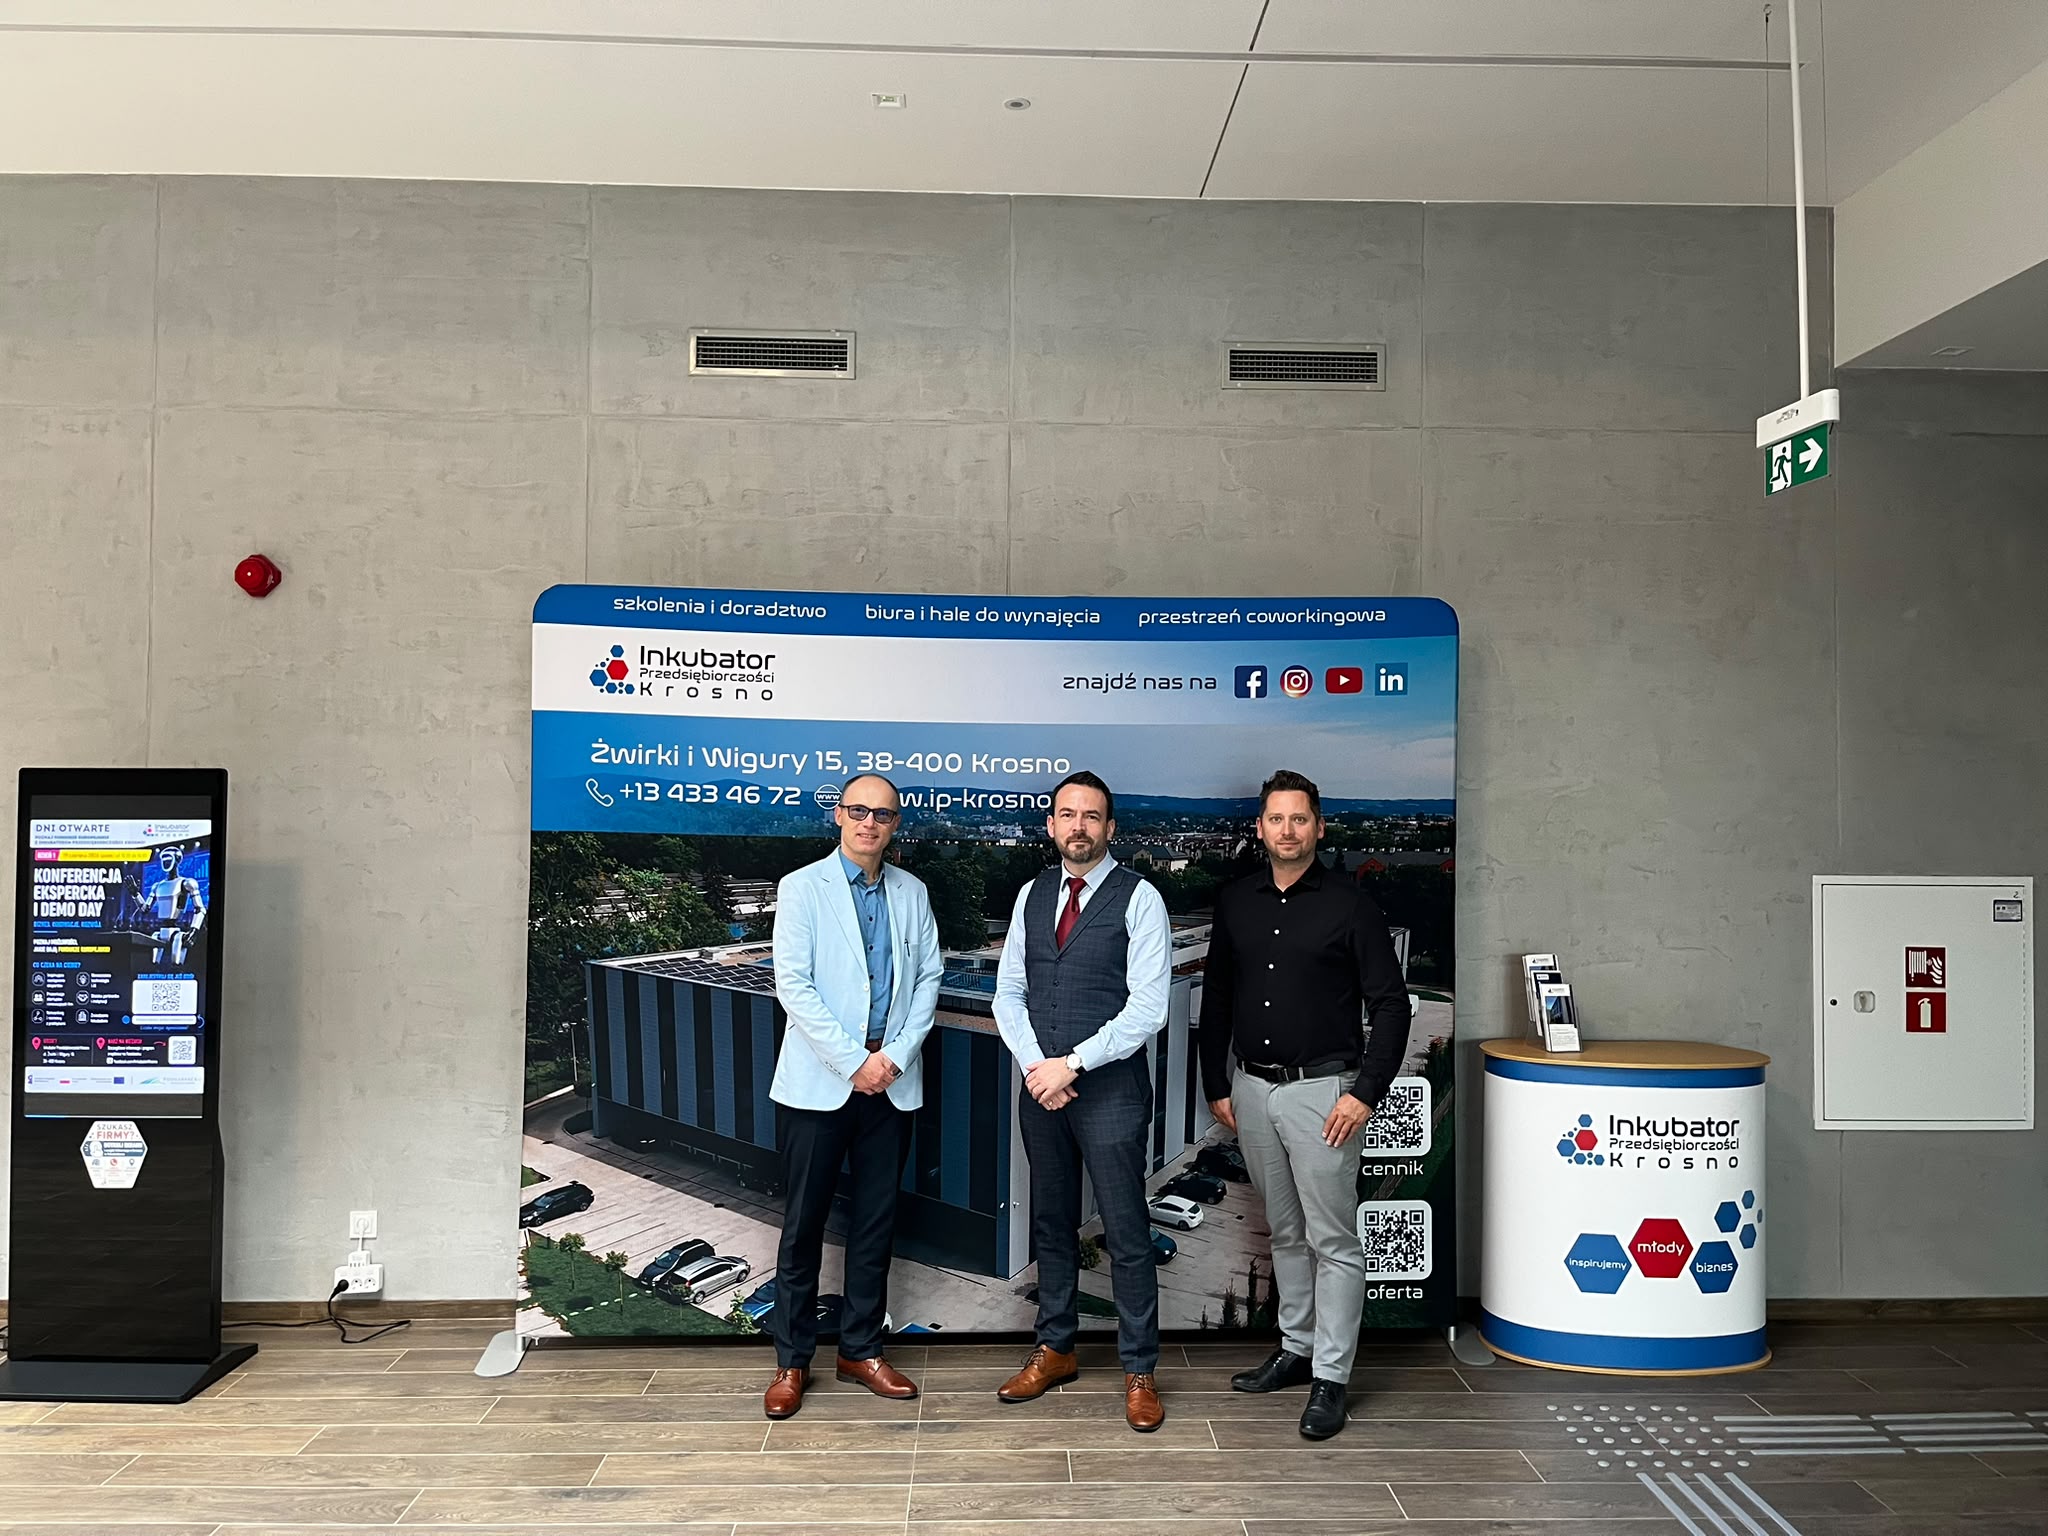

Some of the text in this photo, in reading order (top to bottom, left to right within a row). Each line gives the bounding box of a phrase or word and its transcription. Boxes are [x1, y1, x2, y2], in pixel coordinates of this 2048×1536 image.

[614, 596, 826, 617] szkolenia i doradztwo
[866, 604, 1099, 627] biura i hale do wynajęcia
[1139, 609, 1385, 627] przestrzeń coworkingowa
[639, 645, 776, 670] Inkubator
[639, 667, 775, 684] Przedsiębiorczości
[1063, 672, 1216, 693] znajdź nas na
[1379, 667, 1404, 692] in
[639, 683, 774, 702] Krosno
[591, 738, 1069, 774] Żwirki i Wigury 15, 38-400 Krosno
[620, 783, 801, 804] +13 433 46 72
[899, 788, 1052, 813] w.ip-krosno
[36, 824, 110, 833] DNI OTWARTE
[33, 868, 122, 884] KONFERENCJA
[33, 885, 105, 901] EKSPERCKA
[33, 902, 104, 917] I DEMO DAY
[1609, 1114, 1740, 1138] Inkubator
[97, 1131, 135, 1139] FIRMY?
[1609, 1137, 1740, 1154] Przedsiębiorczości
[1363, 1160, 1423, 1175] cennik
[1609, 1152, 1740, 1170] Krosno
[1637, 1239, 1685, 1256] młody
[1569, 1257, 1628, 1272] inspirujemy
[1695, 1261, 1734, 1274] biznes
[1367, 1285, 1422, 1299] oferta
